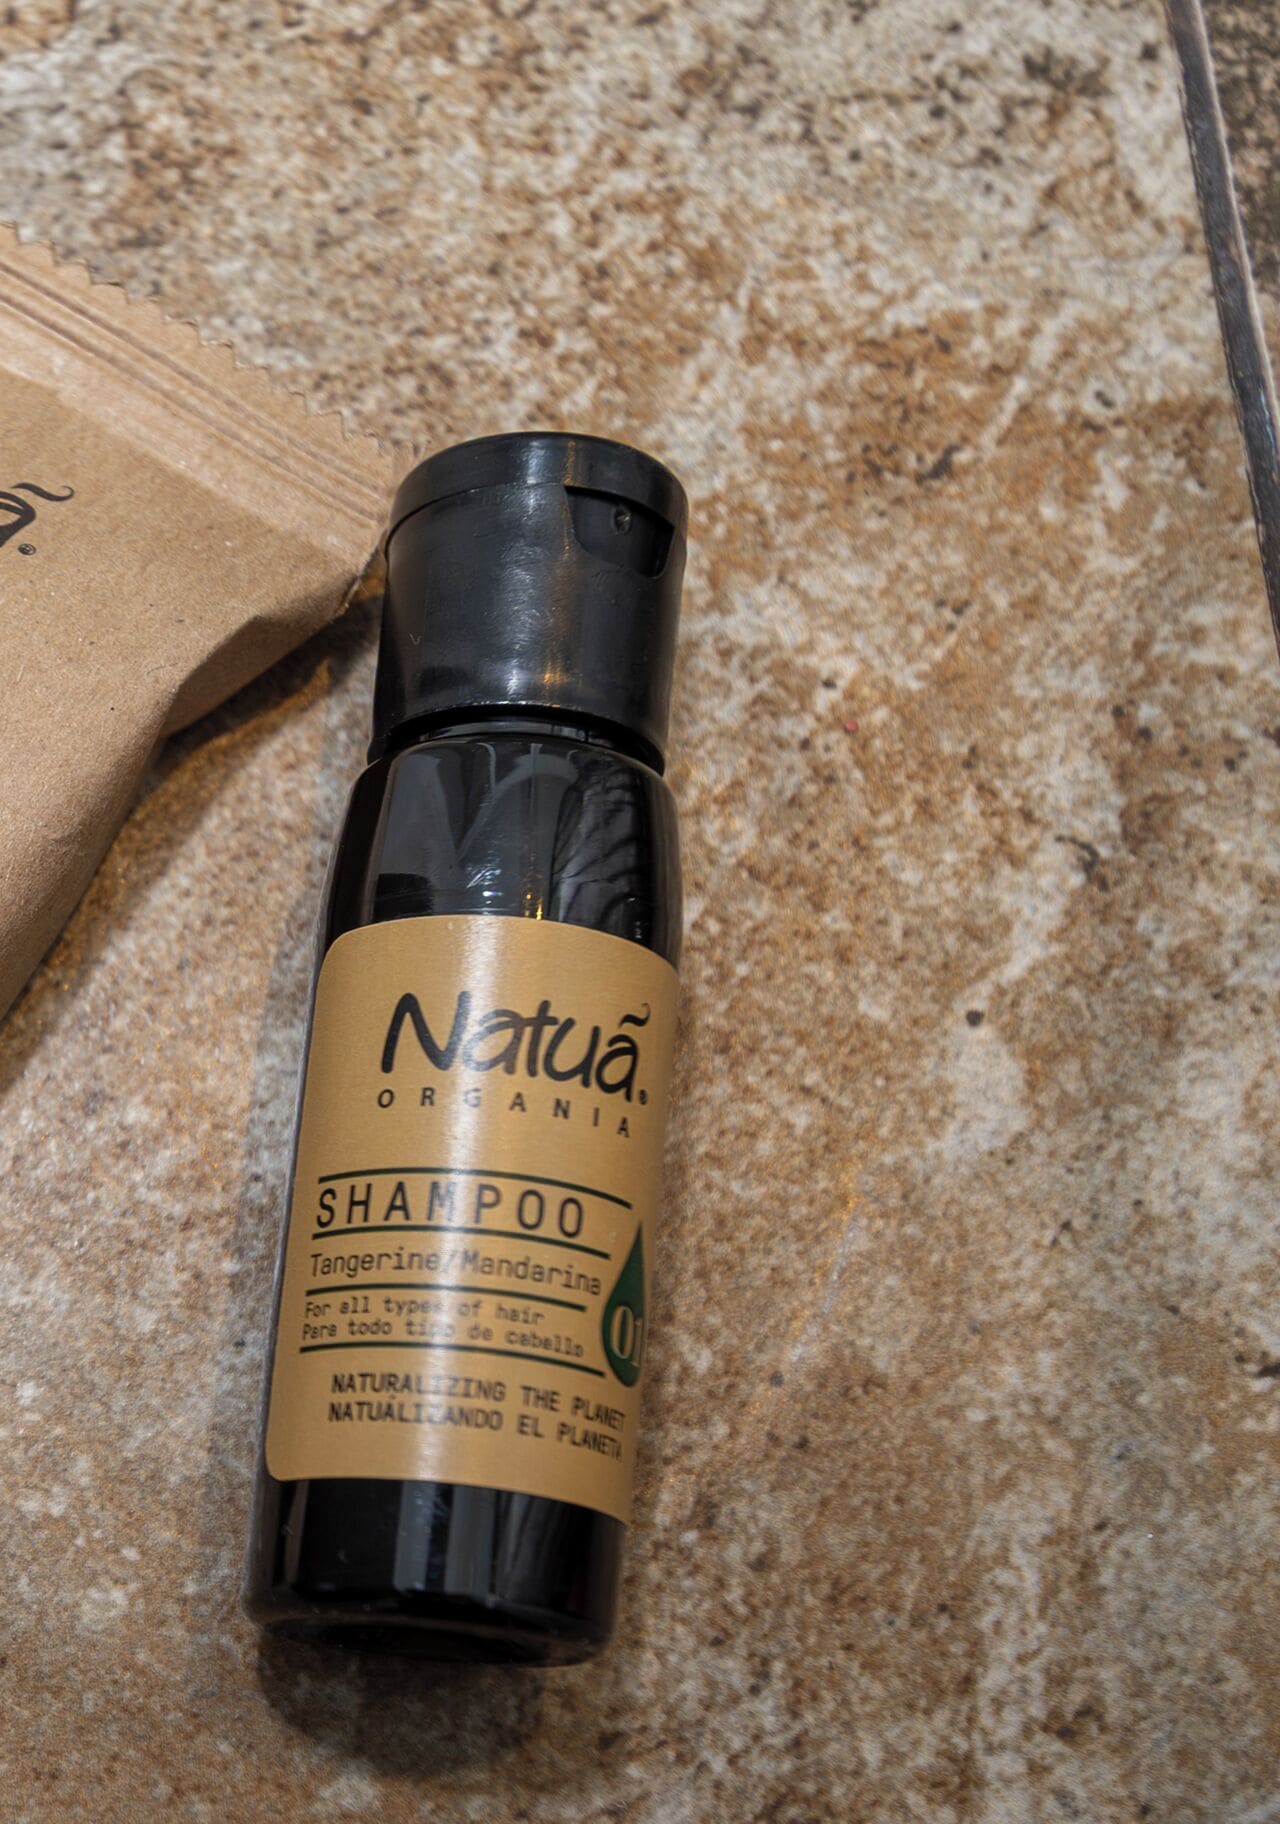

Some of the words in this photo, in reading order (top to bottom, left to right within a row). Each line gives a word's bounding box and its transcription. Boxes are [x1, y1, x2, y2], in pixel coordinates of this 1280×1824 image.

[377, 1086, 631, 1139] ORGANIA
[316, 1180, 584, 1239] SHAMPOO
[305, 1301, 332, 1319] For
[339, 1296, 371, 1315] all
[458, 1301, 483, 1319] of
[496, 1303, 546, 1326] hair
[302, 1323, 338, 1341] Para
[348, 1319, 393, 1336] todo
[407, 1318, 456, 1338] tio
[467, 1322, 494, 1341] de
[505, 1329, 585, 1358] cabello
[331, 1373, 507, 1402] NATURALIZING
[521, 1386, 561, 1413] THE
[571, 1396, 626, 1432] PLANET
[516, 1415, 546, 1438] EL
